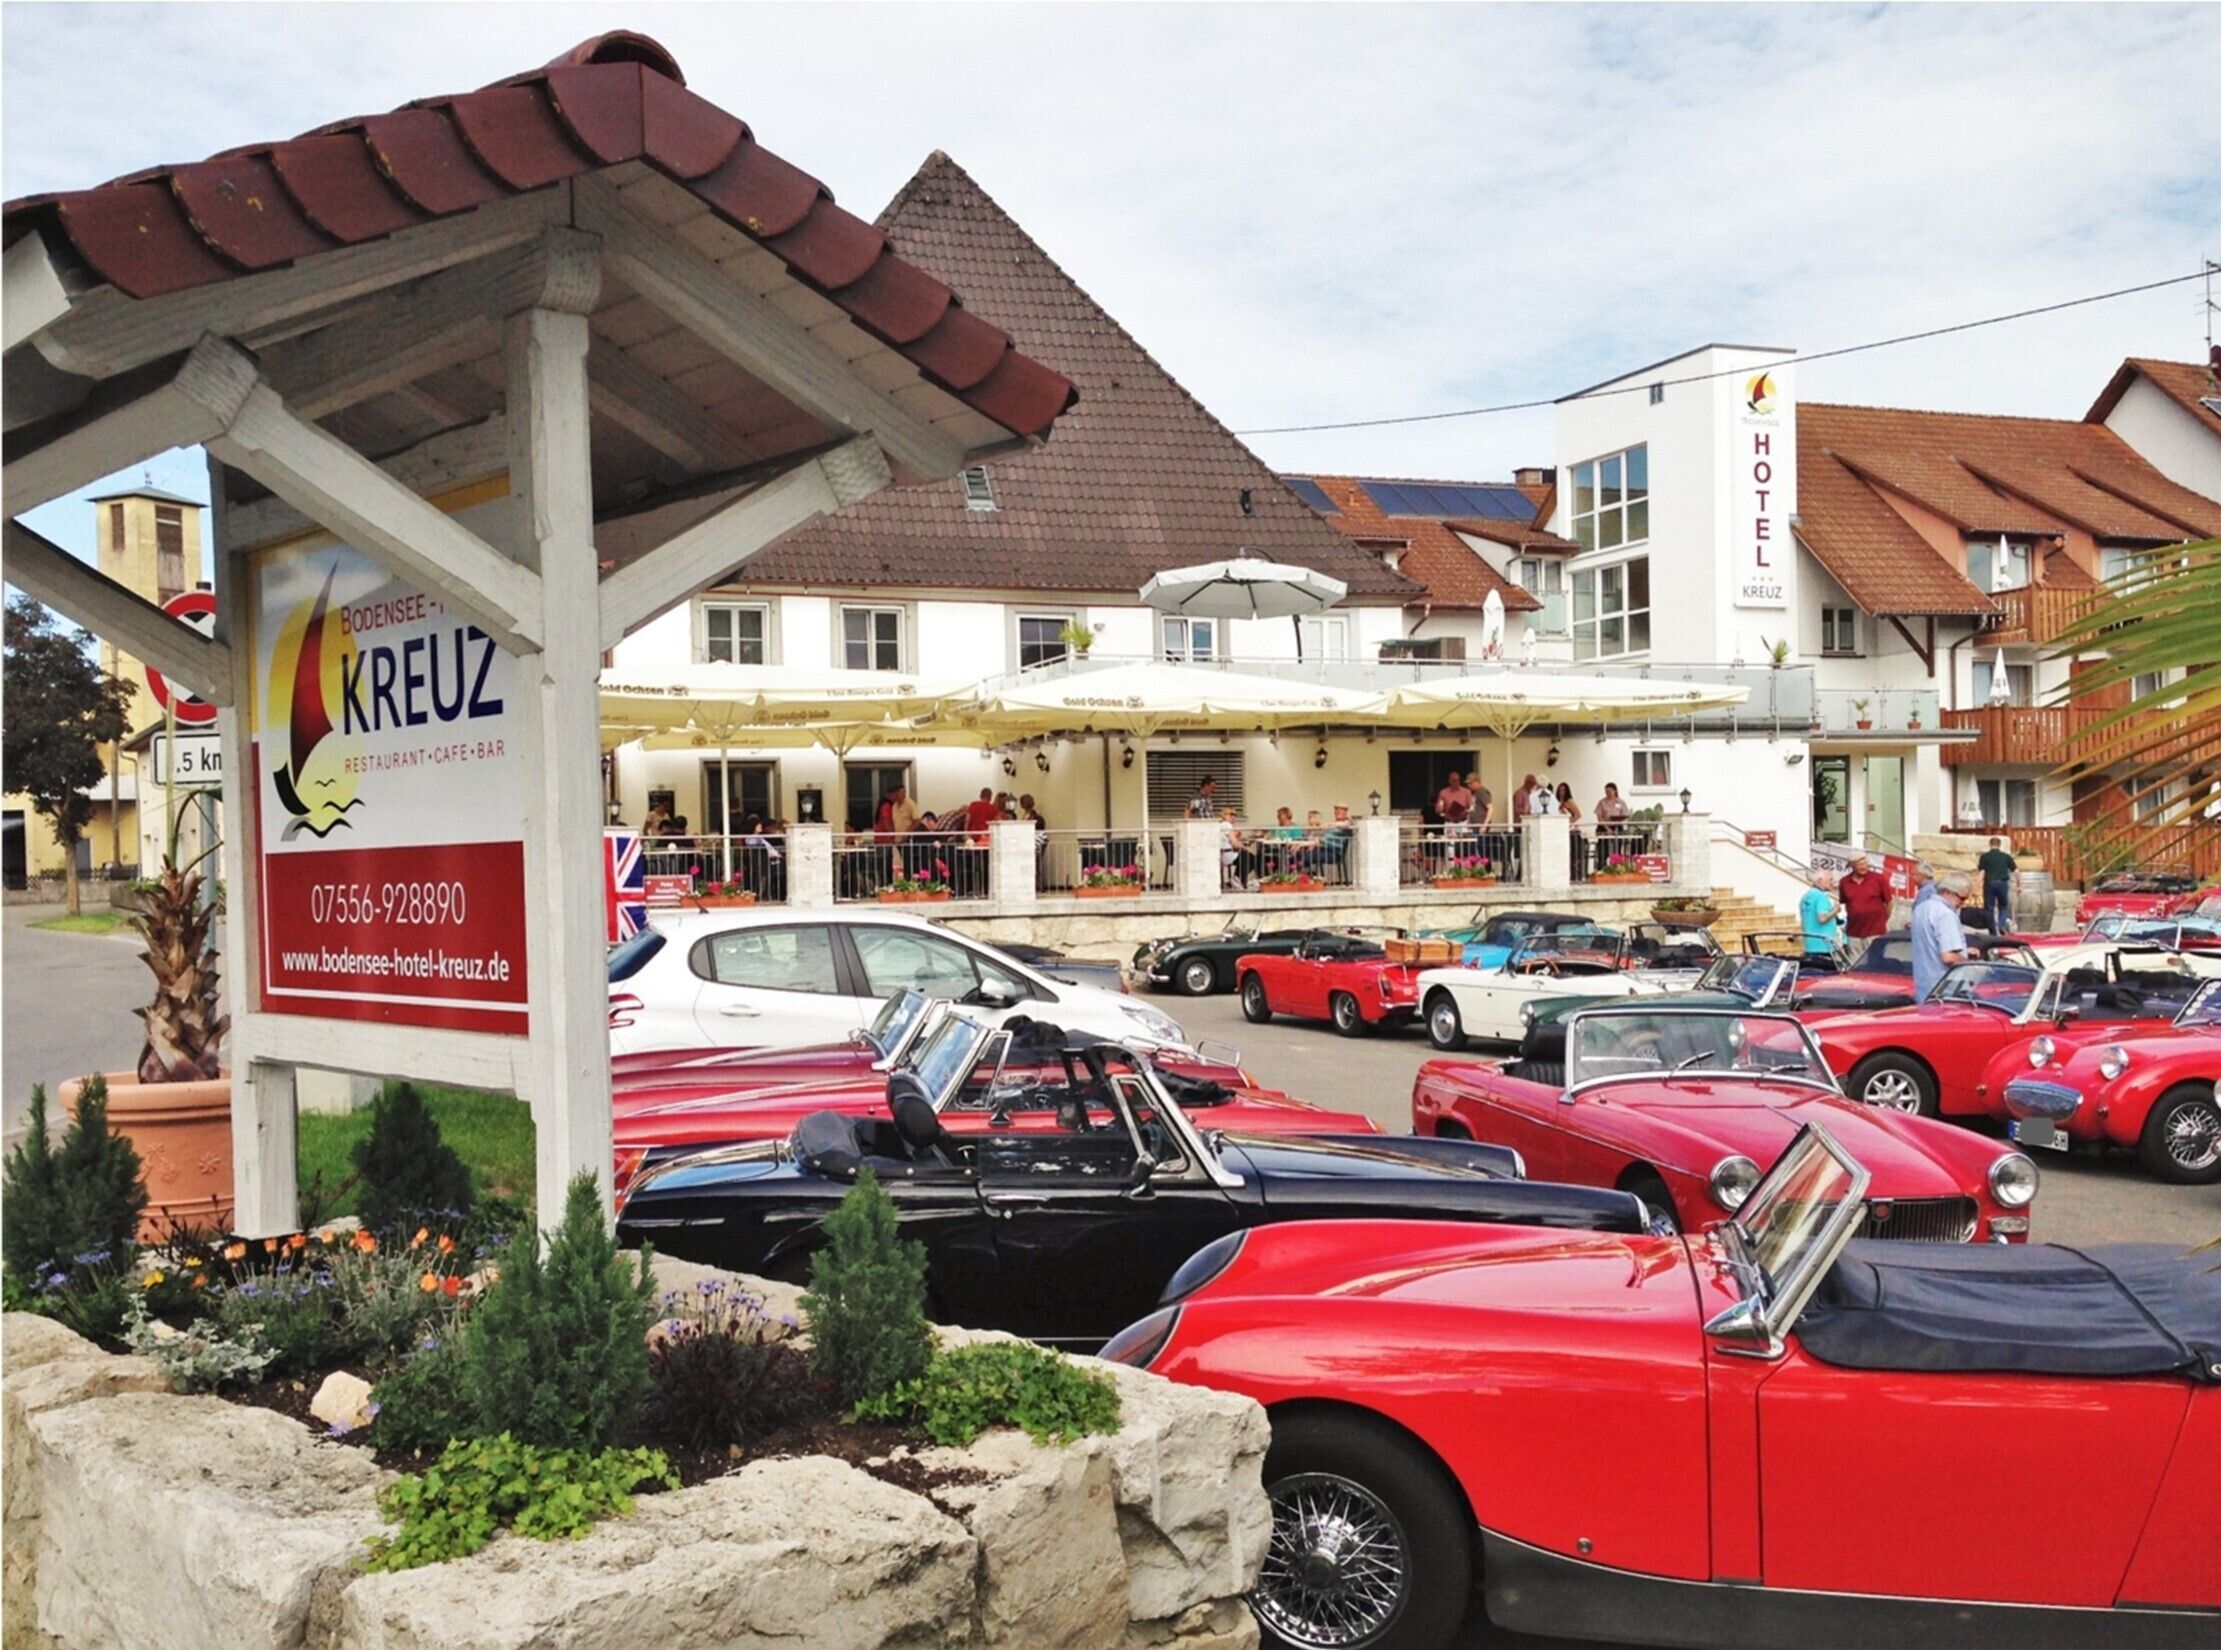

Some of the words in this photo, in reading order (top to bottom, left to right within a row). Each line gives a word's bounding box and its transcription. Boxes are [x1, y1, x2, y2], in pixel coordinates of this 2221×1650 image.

[1754, 433, 1771, 566] HOTEL
[1742, 585, 1782, 599] KREUZ
[341, 594, 443, 635] BODENSEE-
[341, 625, 503, 735] KREUZ
[176, 751, 192, 774] ,5
[311, 881, 466, 925] 07556-928890
[282, 946, 510, 982] www.bodensee-hotel-kreuz.de
